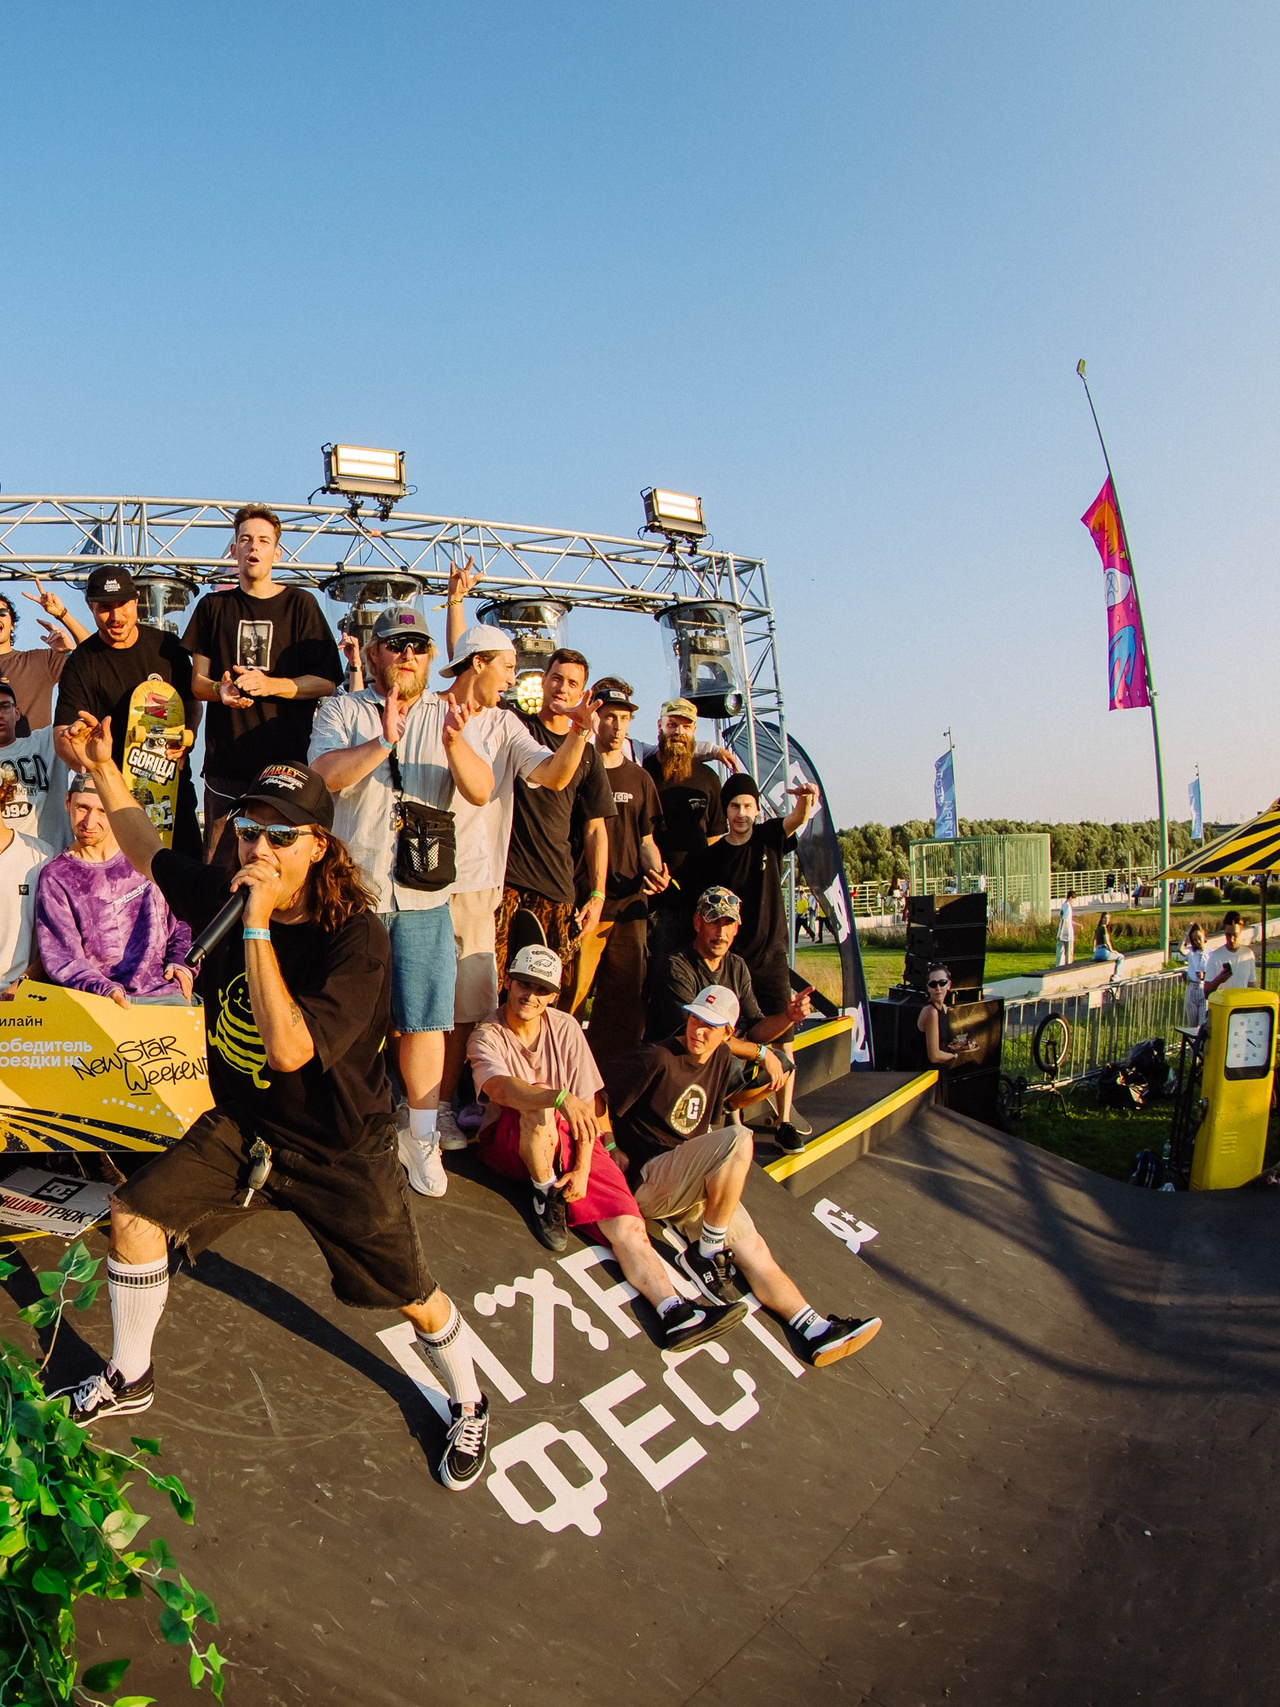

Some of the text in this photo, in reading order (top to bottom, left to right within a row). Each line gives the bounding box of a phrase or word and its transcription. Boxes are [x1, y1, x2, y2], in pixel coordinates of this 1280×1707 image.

[128, 747, 176, 779] GORILLA
[259, 764, 299, 781] HARLEY
[64, 1055, 84, 1068] на
